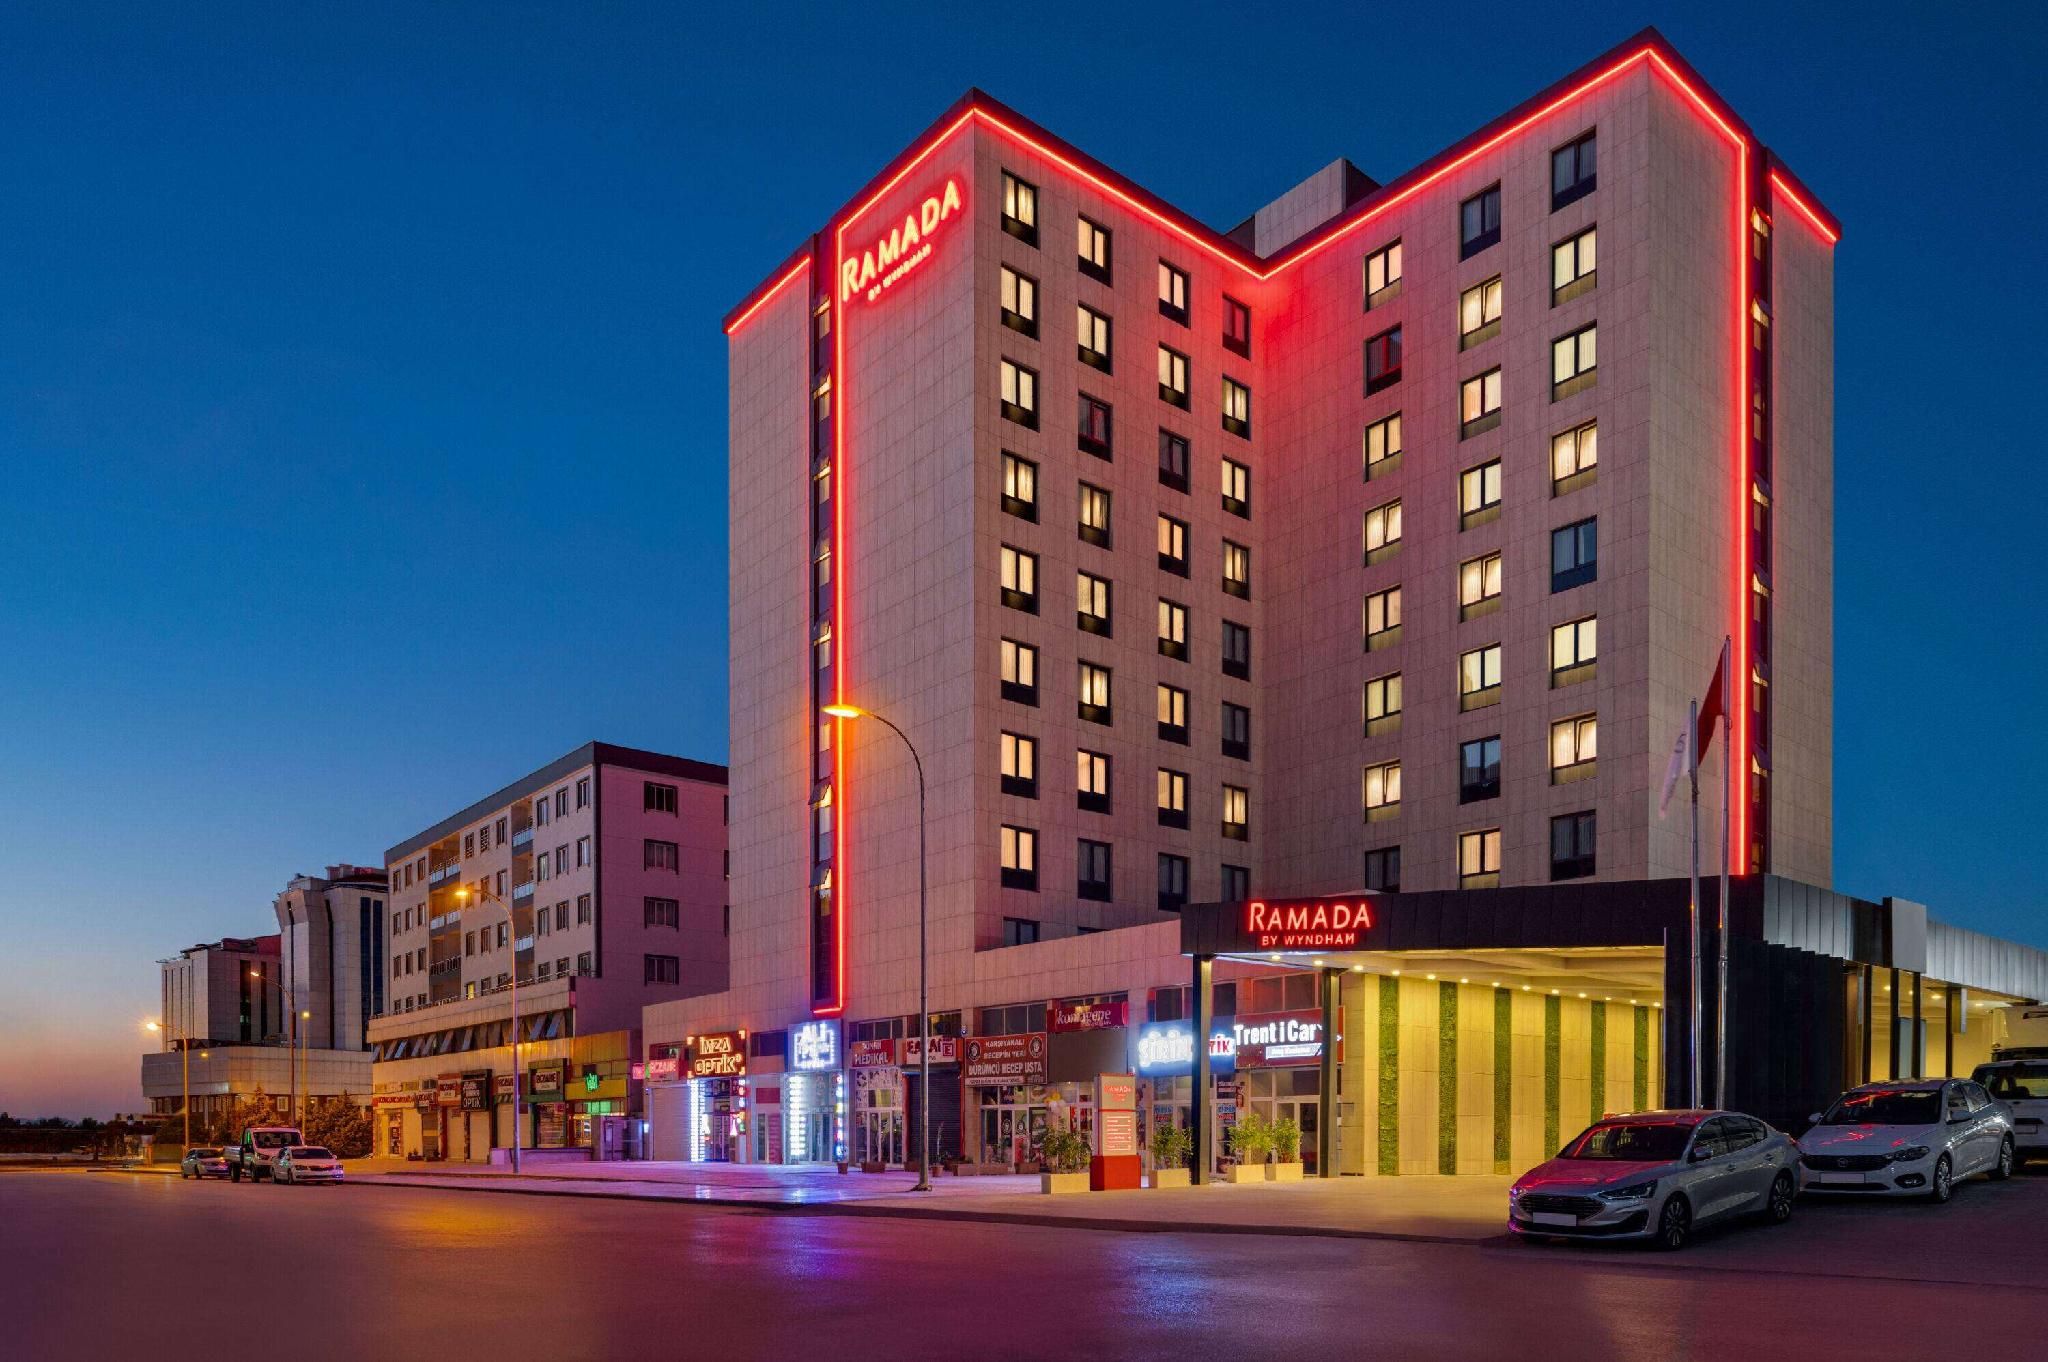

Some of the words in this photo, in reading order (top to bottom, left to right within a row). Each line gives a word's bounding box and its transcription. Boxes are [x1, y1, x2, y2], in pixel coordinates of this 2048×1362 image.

[842, 180, 961, 302] RAMADA
[1248, 902, 1371, 932] RAMADA
[1262, 935, 1278, 946] BY
[1284, 933, 1355, 946] WYNDHAM
[694, 1053, 737, 1075] OPTİK
[1024, 1061, 1043, 1073] USTA
